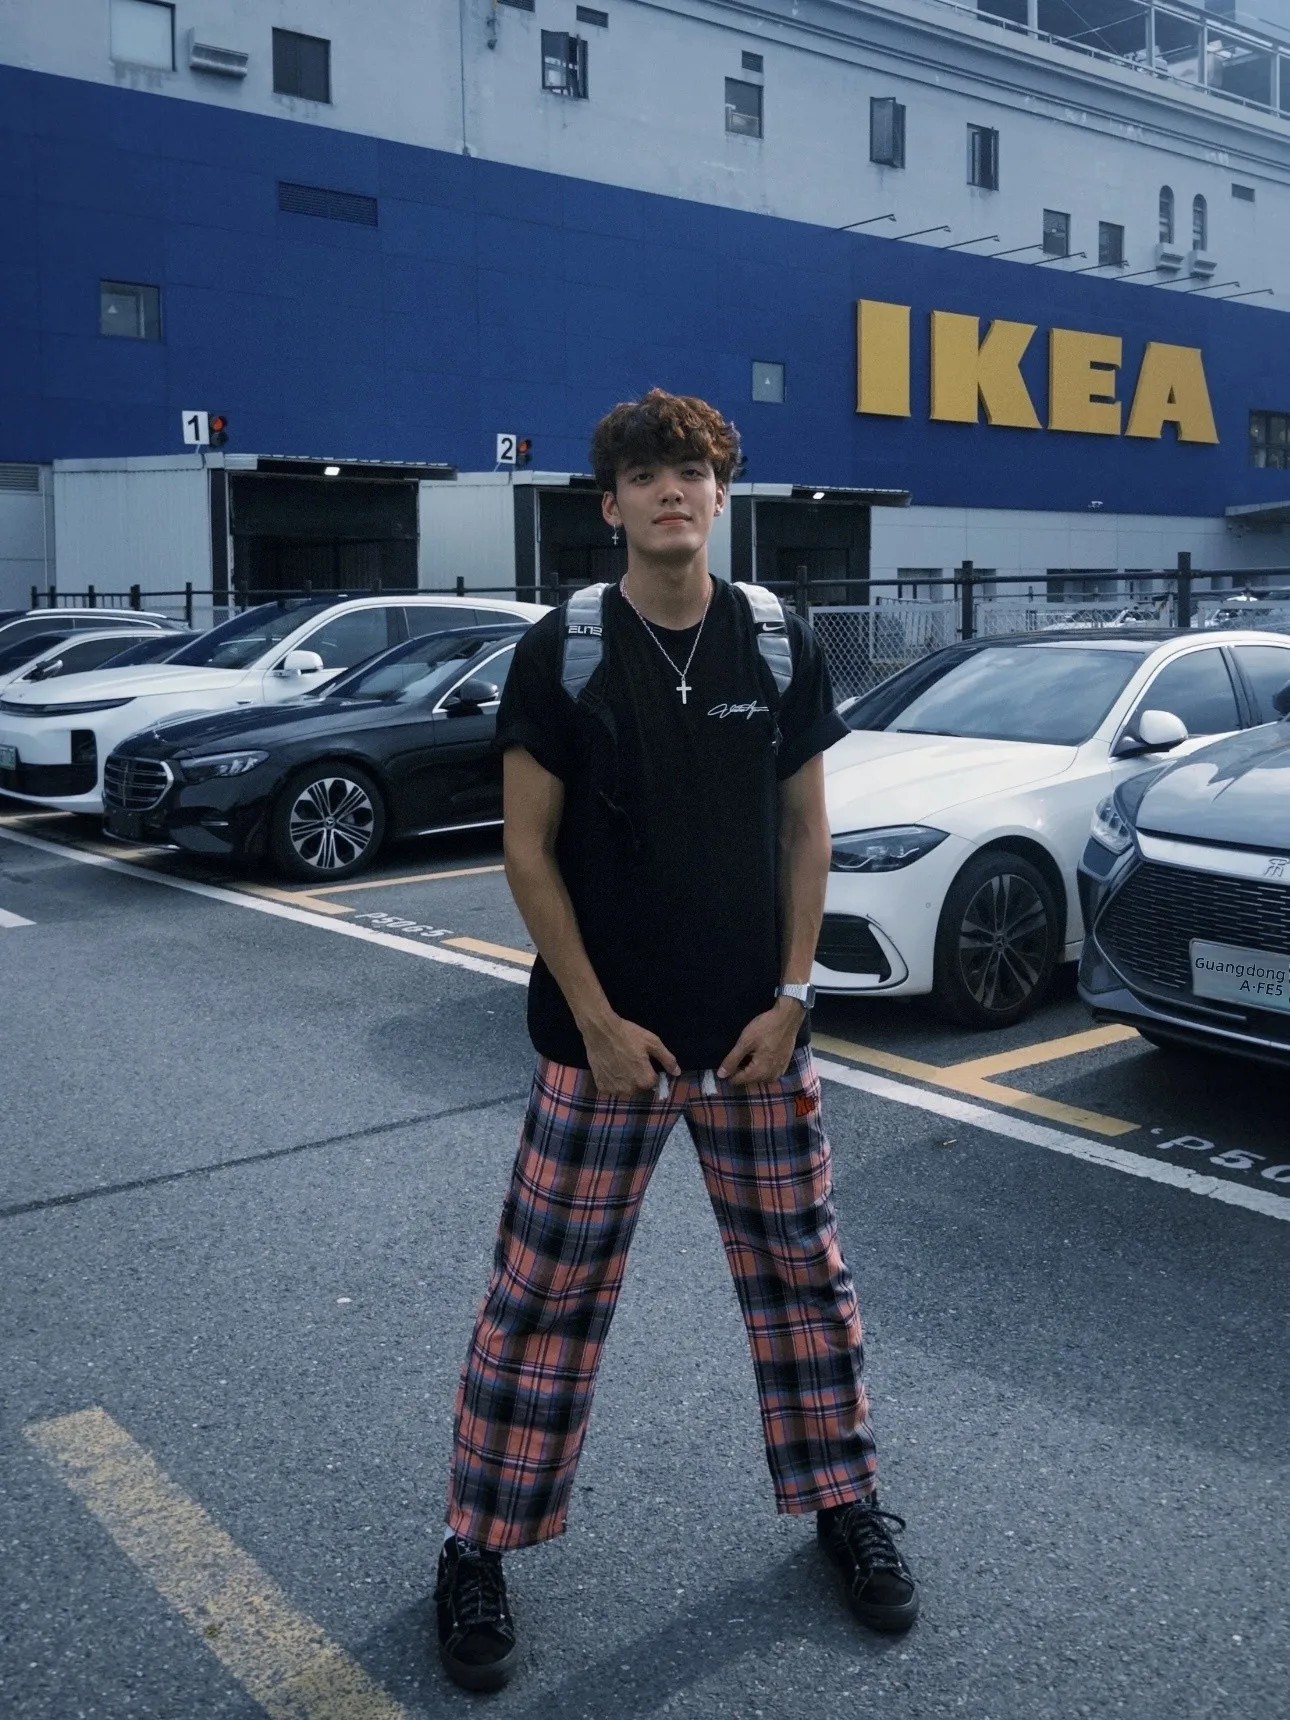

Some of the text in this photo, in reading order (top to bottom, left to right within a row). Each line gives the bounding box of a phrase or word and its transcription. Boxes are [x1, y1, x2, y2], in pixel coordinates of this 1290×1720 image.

[856, 298, 1220, 444] IKEA
[188, 415, 200, 441] 1
[501, 437, 513, 460] 2
[354, 912, 455, 937] P5065
[1195, 957, 1286, 984] Guangdong
